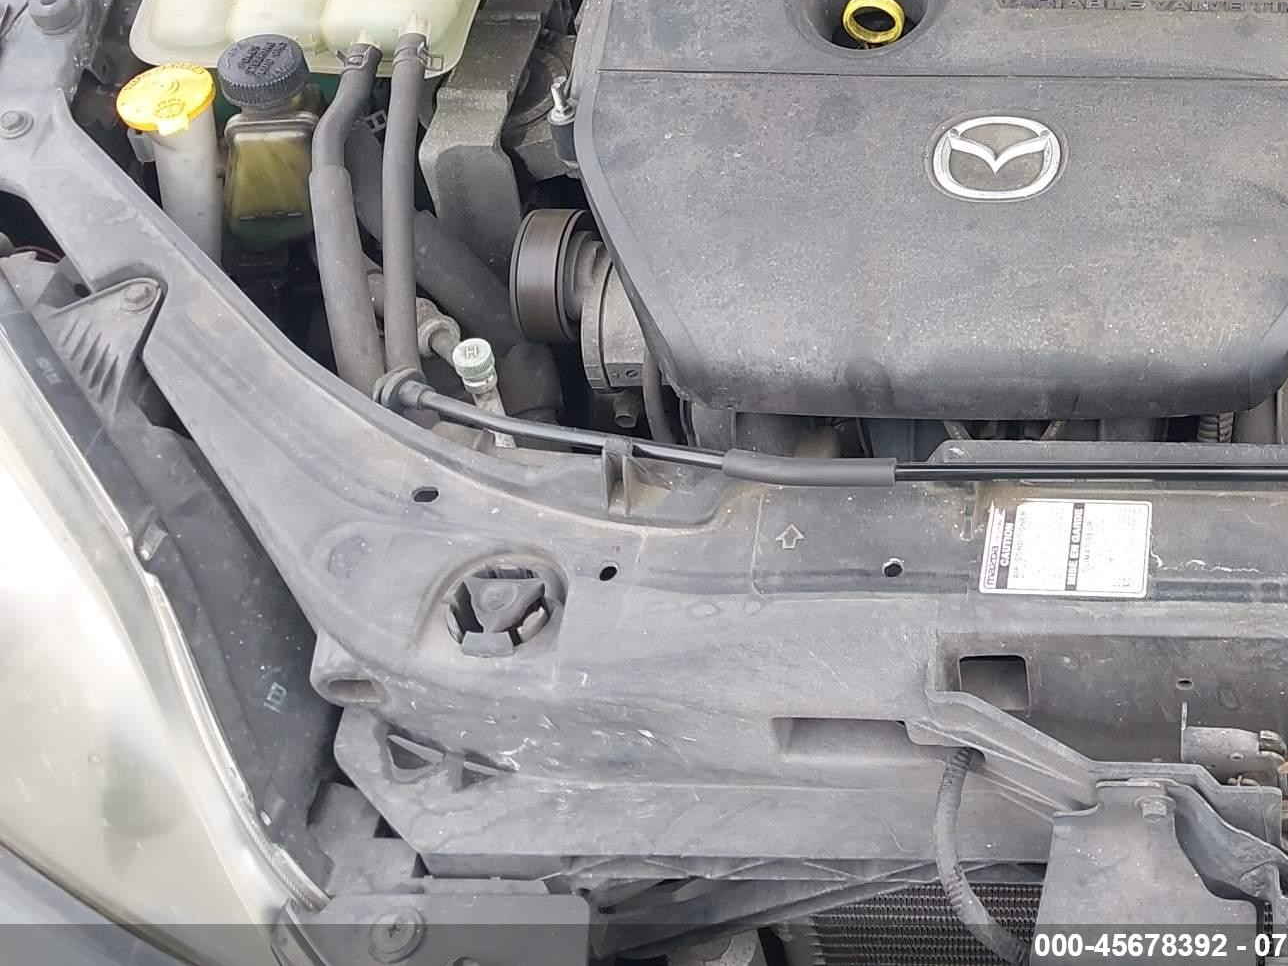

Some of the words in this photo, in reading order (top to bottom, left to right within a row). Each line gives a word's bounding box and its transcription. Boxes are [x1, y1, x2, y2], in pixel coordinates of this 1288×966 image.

[1150, 0, 1246, 12] VALVE
[464, 345, 479, 360] H
[1071, 508, 1084, 543] GARDE
[1000, 521, 1014, 567] CAUTION
[1070, 543, 1080, 560] EN
[1066, 559, 1079, 585] MISE
